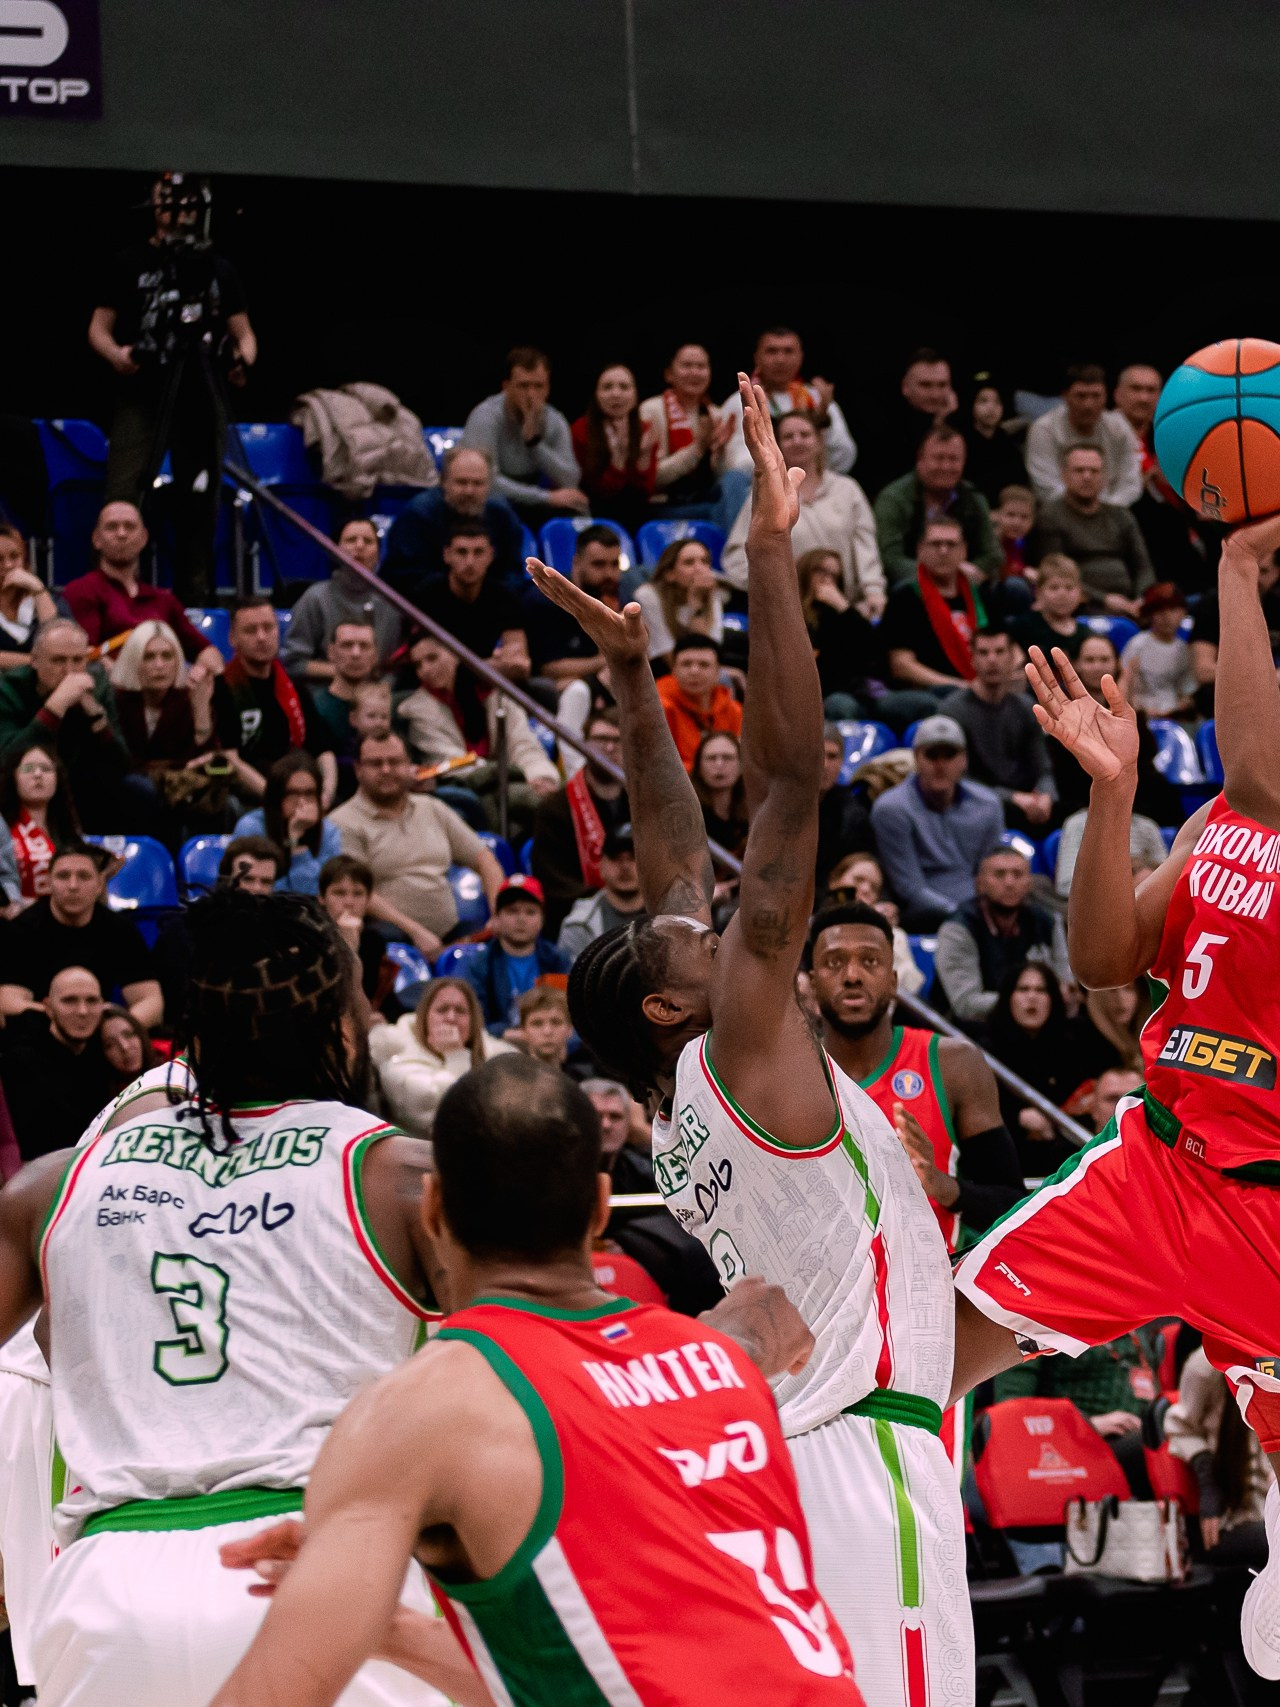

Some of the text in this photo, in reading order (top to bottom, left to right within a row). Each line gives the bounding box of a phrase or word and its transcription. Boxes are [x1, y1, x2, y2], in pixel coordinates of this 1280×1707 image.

[1190, 859, 1275, 920] KUBAN
[1182, 931, 1230, 1000] 5
[1160, 1029, 1272, 1079] ЕЛБЕТ
[100, 1124, 331, 1188] REYNOLDS
[96, 1208, 147, 1227] Банк
[100, 1184, 185, 1210] Ак Барс
[151, 1250, 230, 1387] 3
[582, 1341, 745, 1408] HUNTER
